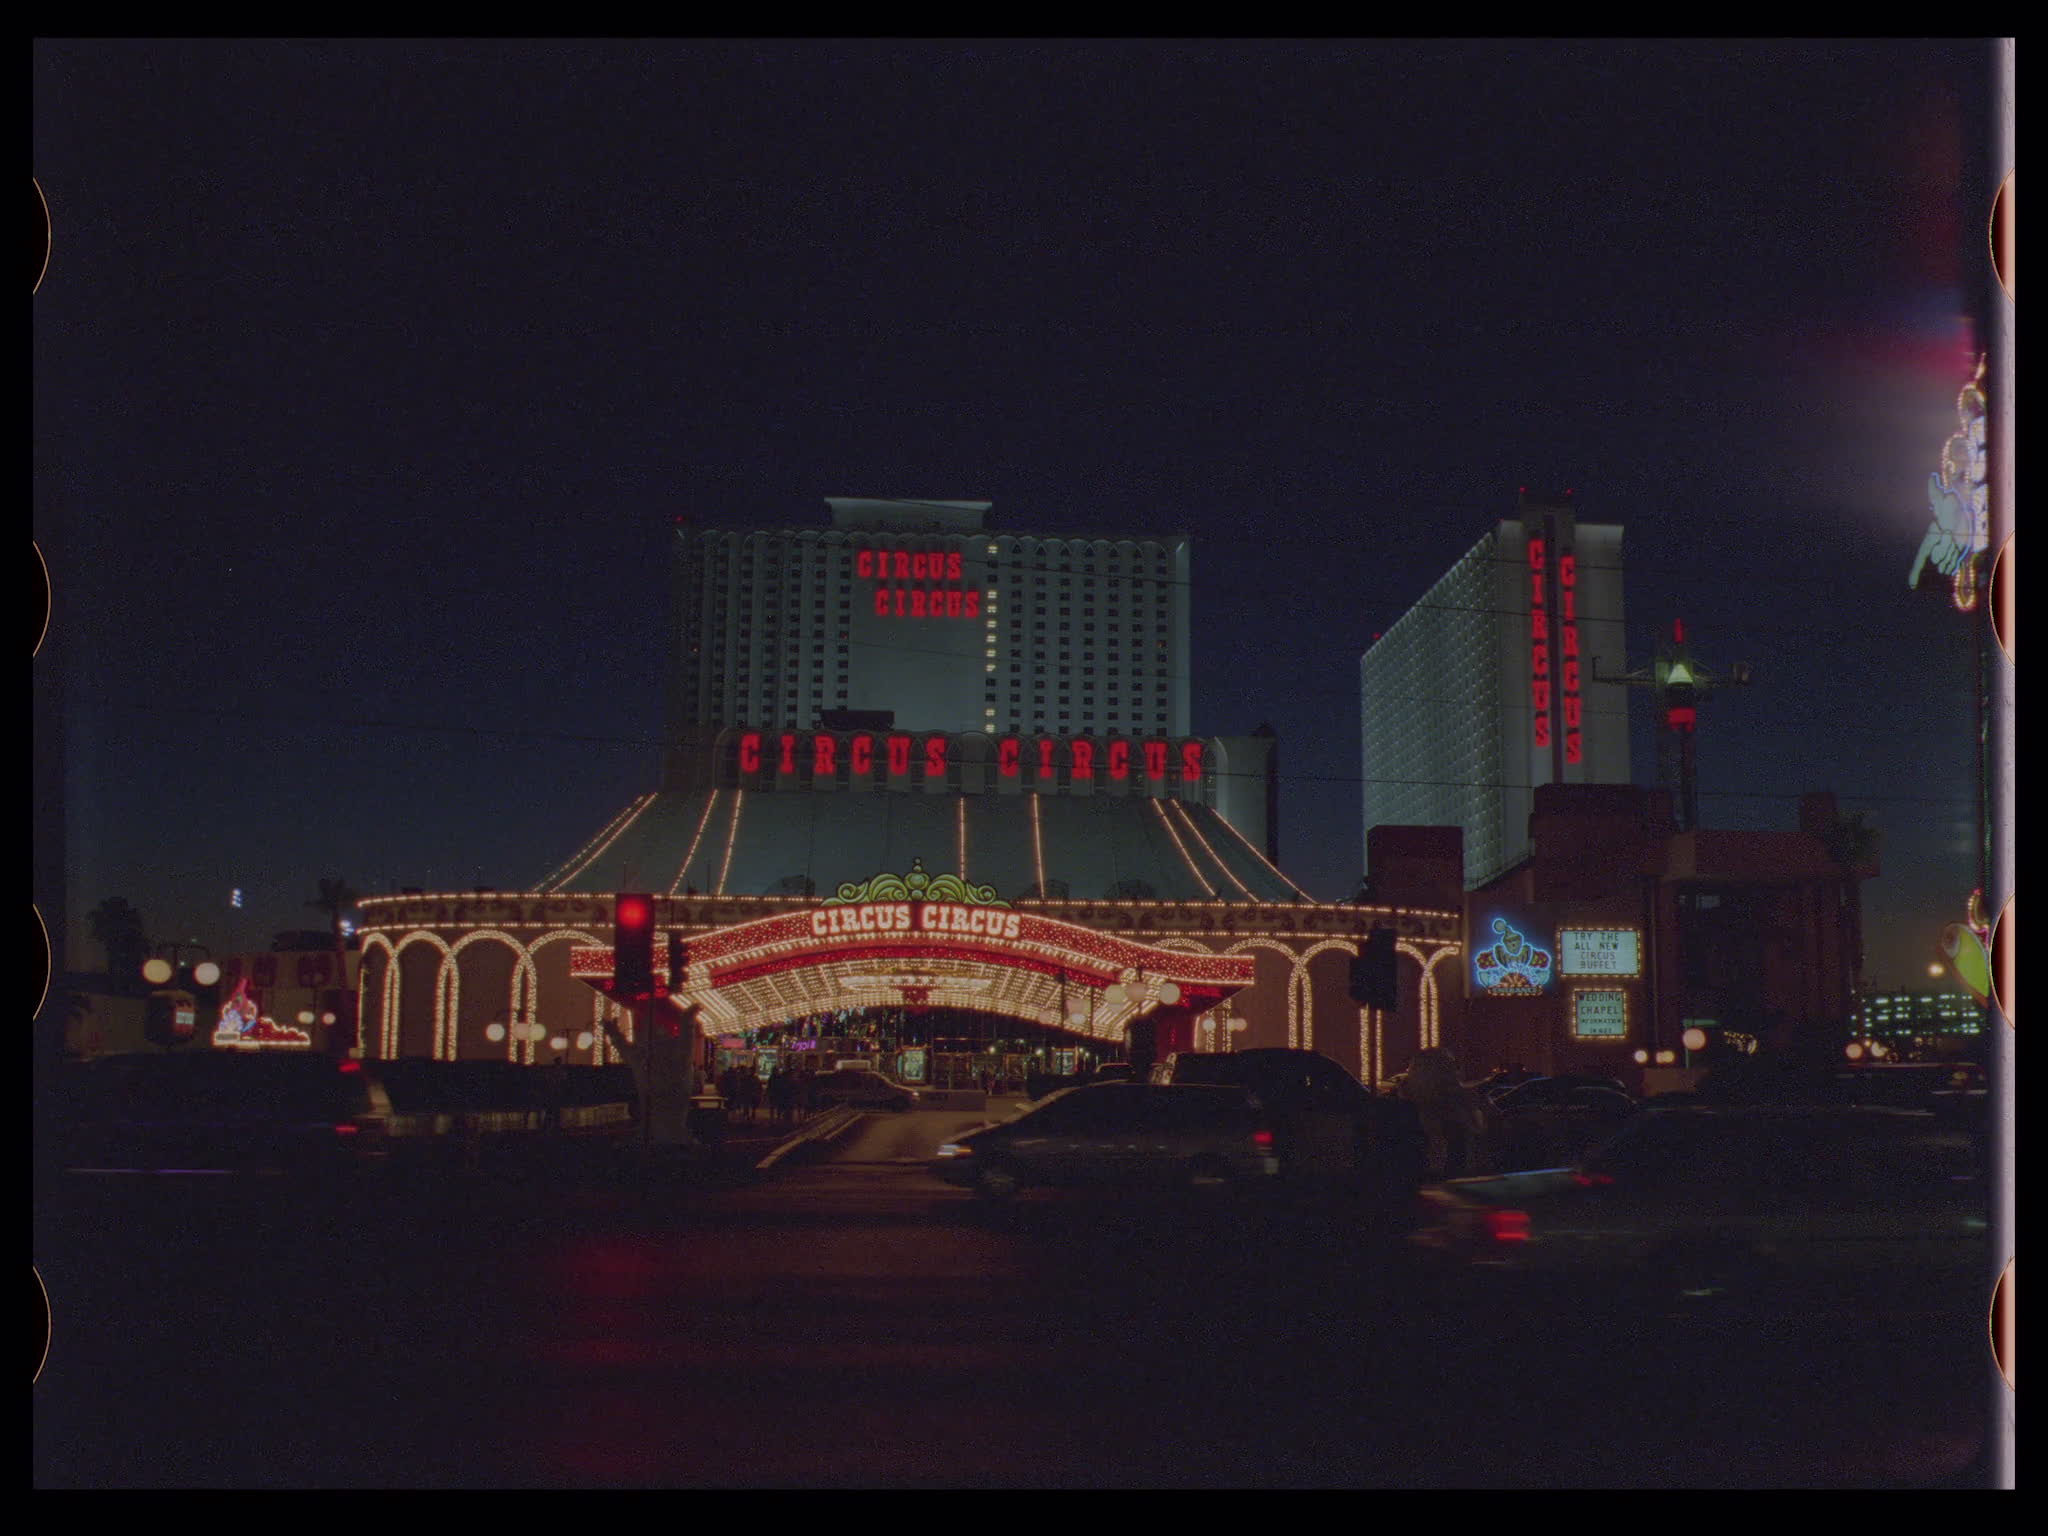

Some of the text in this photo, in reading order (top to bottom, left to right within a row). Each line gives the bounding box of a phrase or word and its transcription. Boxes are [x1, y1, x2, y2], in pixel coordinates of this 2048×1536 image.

[858, 551, 962, 580] CIRCUS
[875, 588, 980, 618] CIRCUS
[1529, 539, 1551, 748] CIRCUS
[1560, 555, 1582, 765] CIRCUS
[740, 733, 1202, 782] CIRCUS CIRCUS
[811, 905, 1021, 938] CIRCUS CIRCUS
[1574, 932, 1619, 941] TRY THE
[1574, 943, 1619, 951] ALL NEW
[1580, 952, 1615, 960] CIRCUS
[1580, 961, 1616, 969] BUFFET
[1578, 992, 1621, 1001] WEDDING
[1581, 1006, 1618, 1014] CHAPEL
